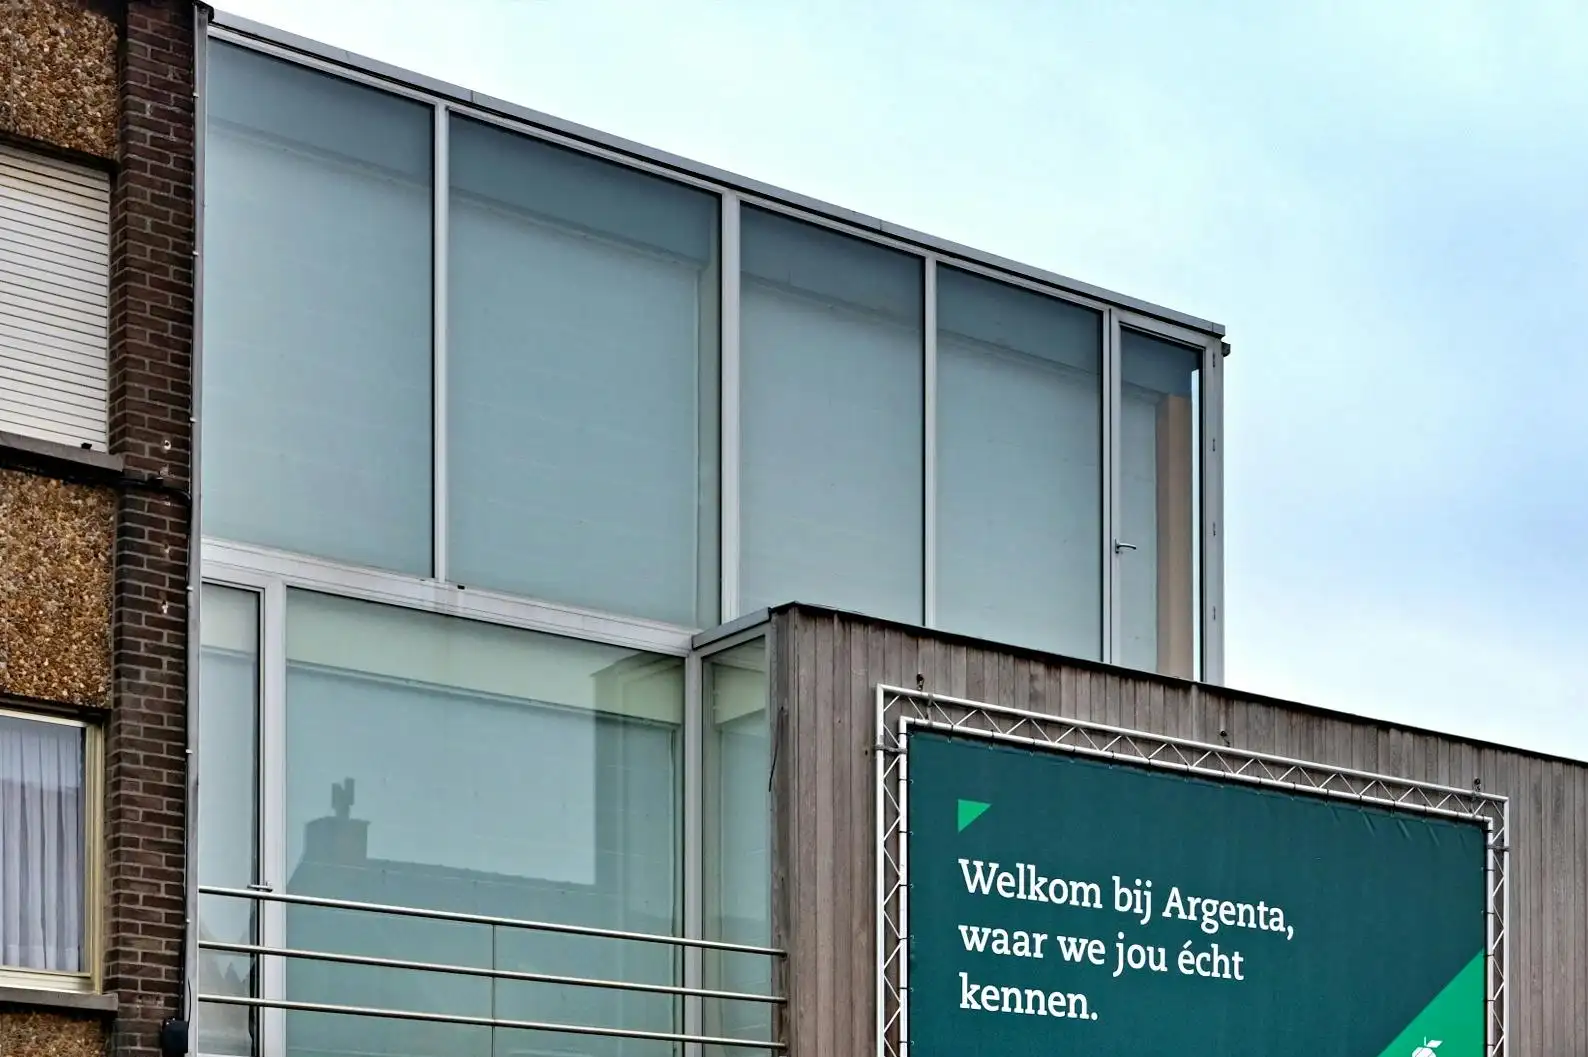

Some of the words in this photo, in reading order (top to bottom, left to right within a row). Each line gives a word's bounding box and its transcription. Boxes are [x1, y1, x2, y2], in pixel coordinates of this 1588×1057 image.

[958, 858, 1103, 909] Welkom
[1112, 875, 1152, 925] bij
[1162, 886, 1294, 940] Argenta,
[958, 924, 1048, 959] waar
[1056, 934, 1106, 965] we
[1112, 931, 1168, 977] jou
[1177, 939, 1245, 981] écht
[958, 971, 1099, 1021] kennen.
